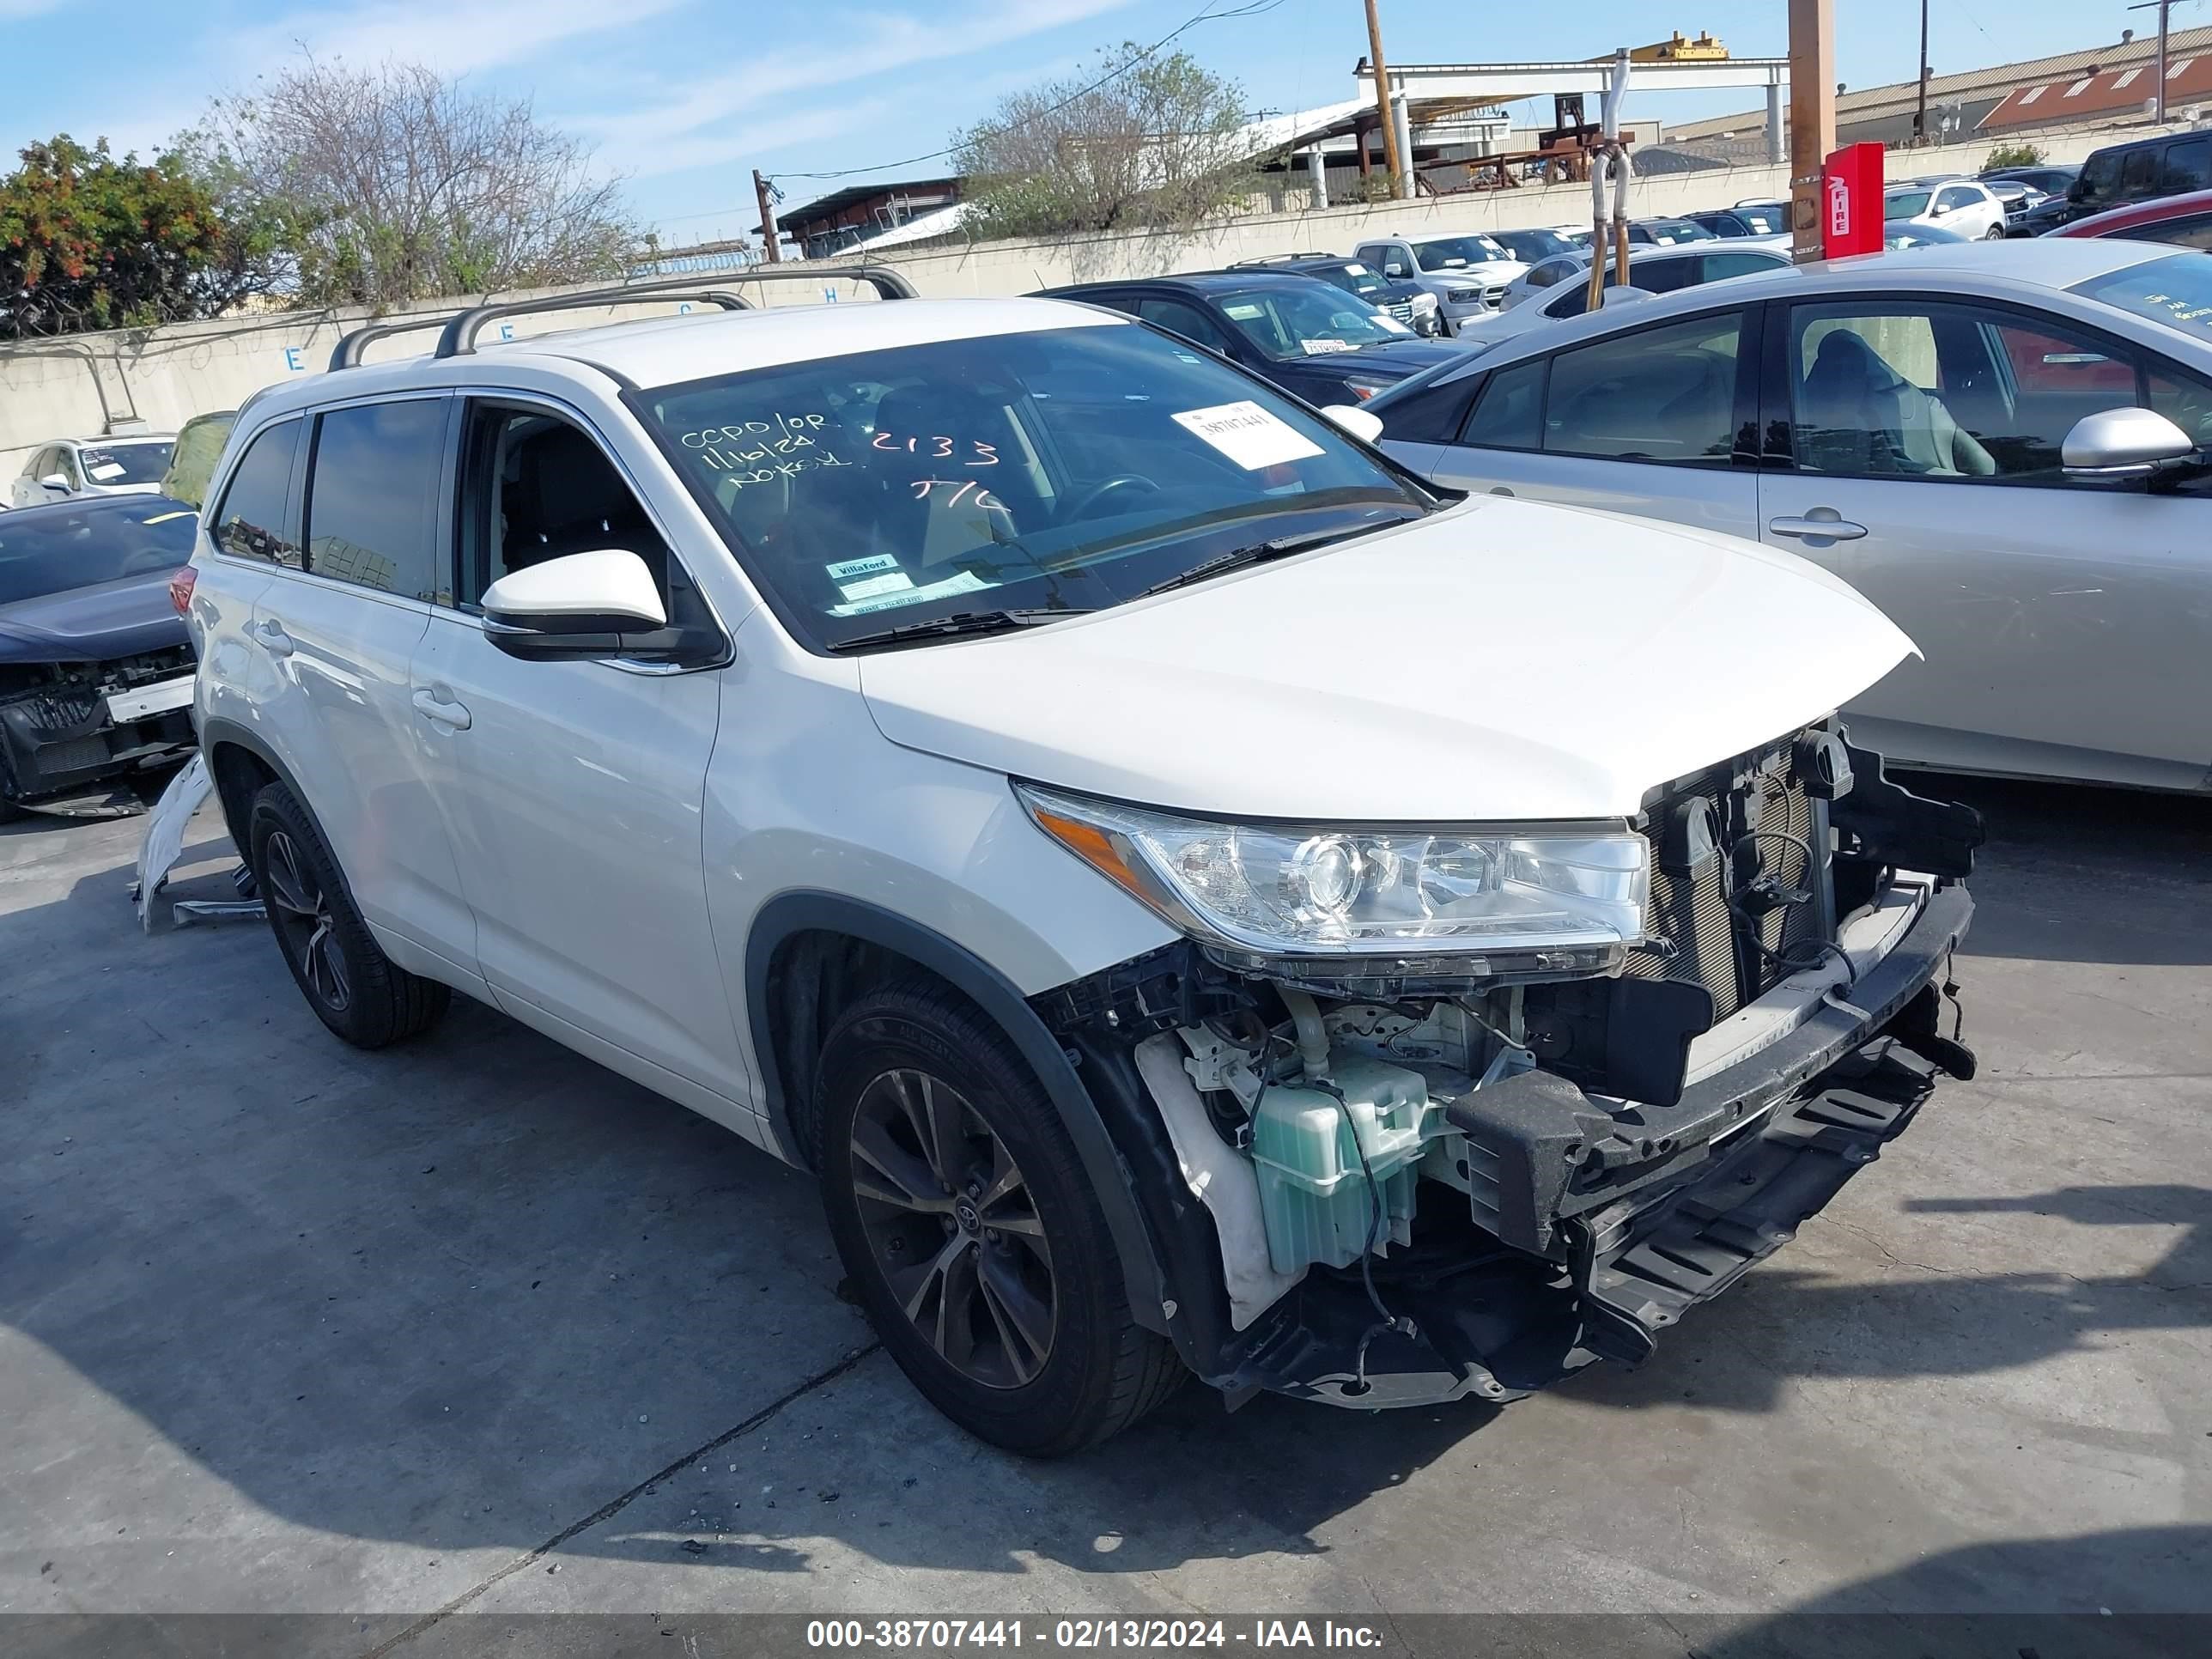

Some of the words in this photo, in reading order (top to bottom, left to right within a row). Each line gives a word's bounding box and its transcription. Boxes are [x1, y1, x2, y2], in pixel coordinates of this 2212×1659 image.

[1835, 190, 1845, 231] FIRE
[824, 287, 837, 303] H
[285, 348, 304, 370] E
[872, 432, 1000, 465] 2133
